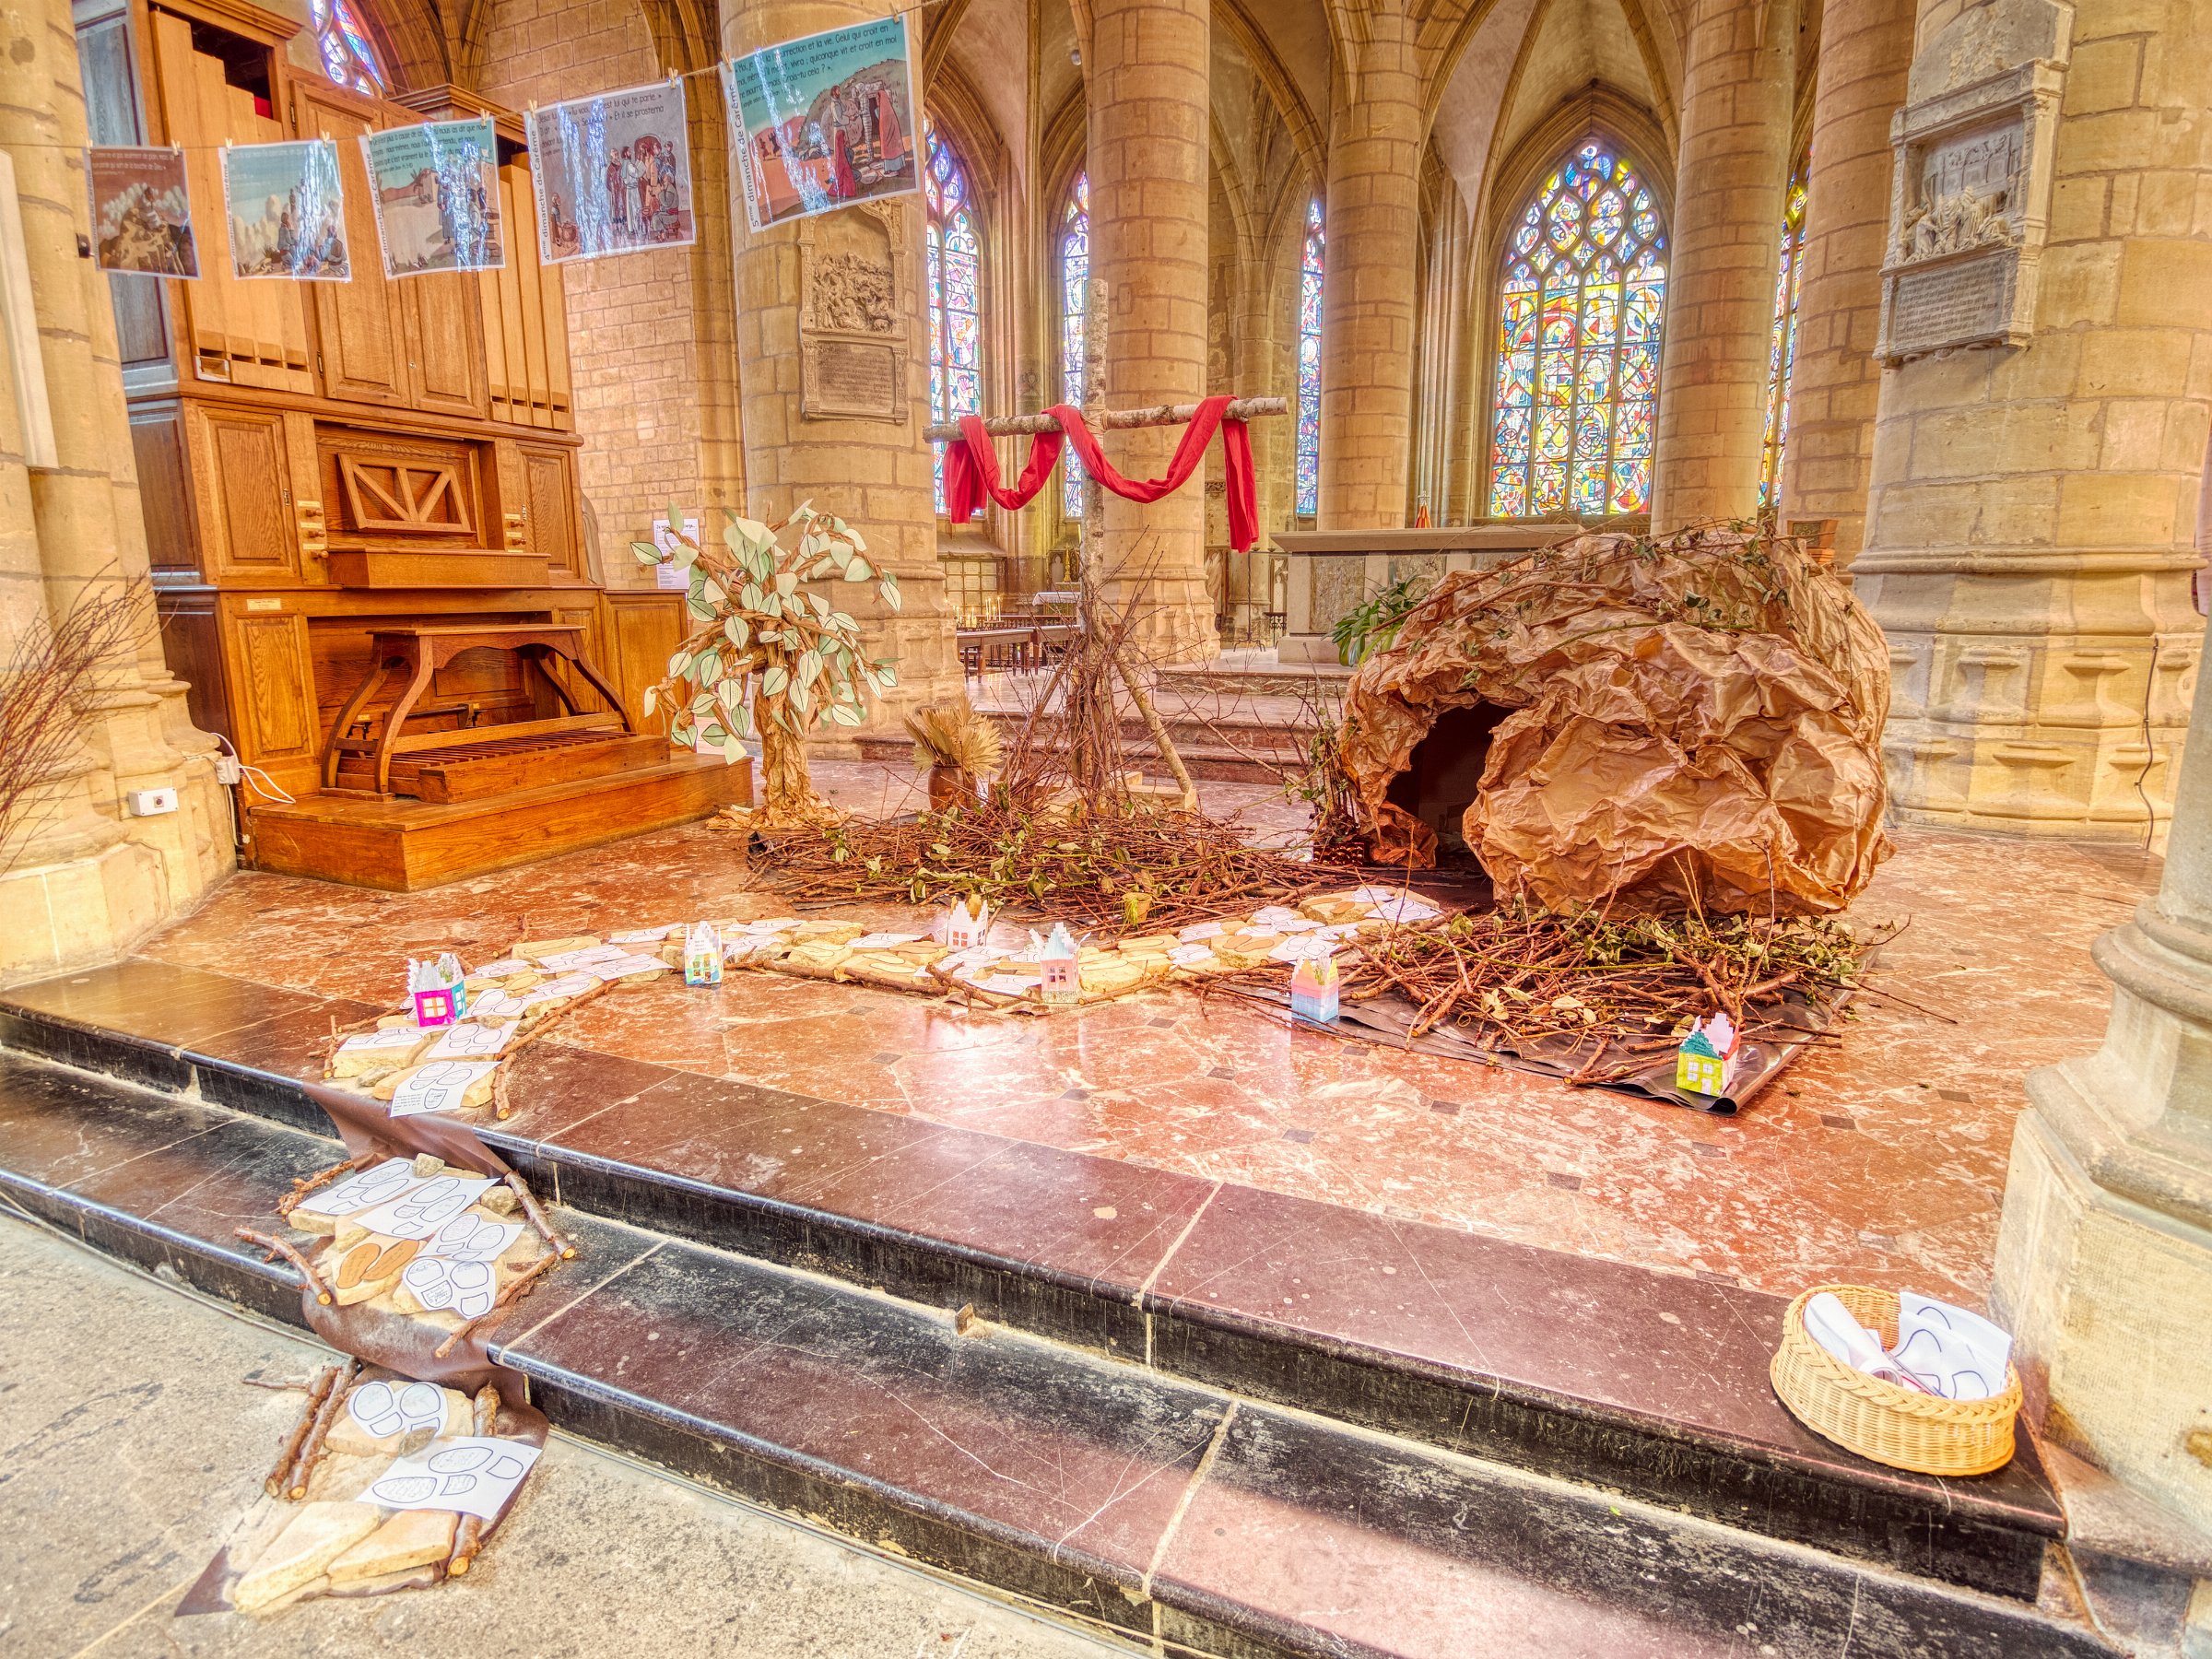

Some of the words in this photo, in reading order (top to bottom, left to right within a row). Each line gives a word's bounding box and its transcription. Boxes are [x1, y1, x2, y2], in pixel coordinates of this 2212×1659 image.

[836, 33, 850, 43] Celui
[853, 30, 861, 41] qui
[864, 27, 877, 37] croit
[880, 25, 888, 33] en
[810, 51, 839, 65] quiconque
[729, 83, 742, 128] Carême
[532, 131, 542, 171] Carême
[737, 131, 746, 147] de
[366, 154, 377, 191] Carême
[535, 172, 543, 186] de
[741, 148, 755, 202] dimanche
[377, 209, 388, 253] dimanche
[538, 188, 548, 238] dimanche
